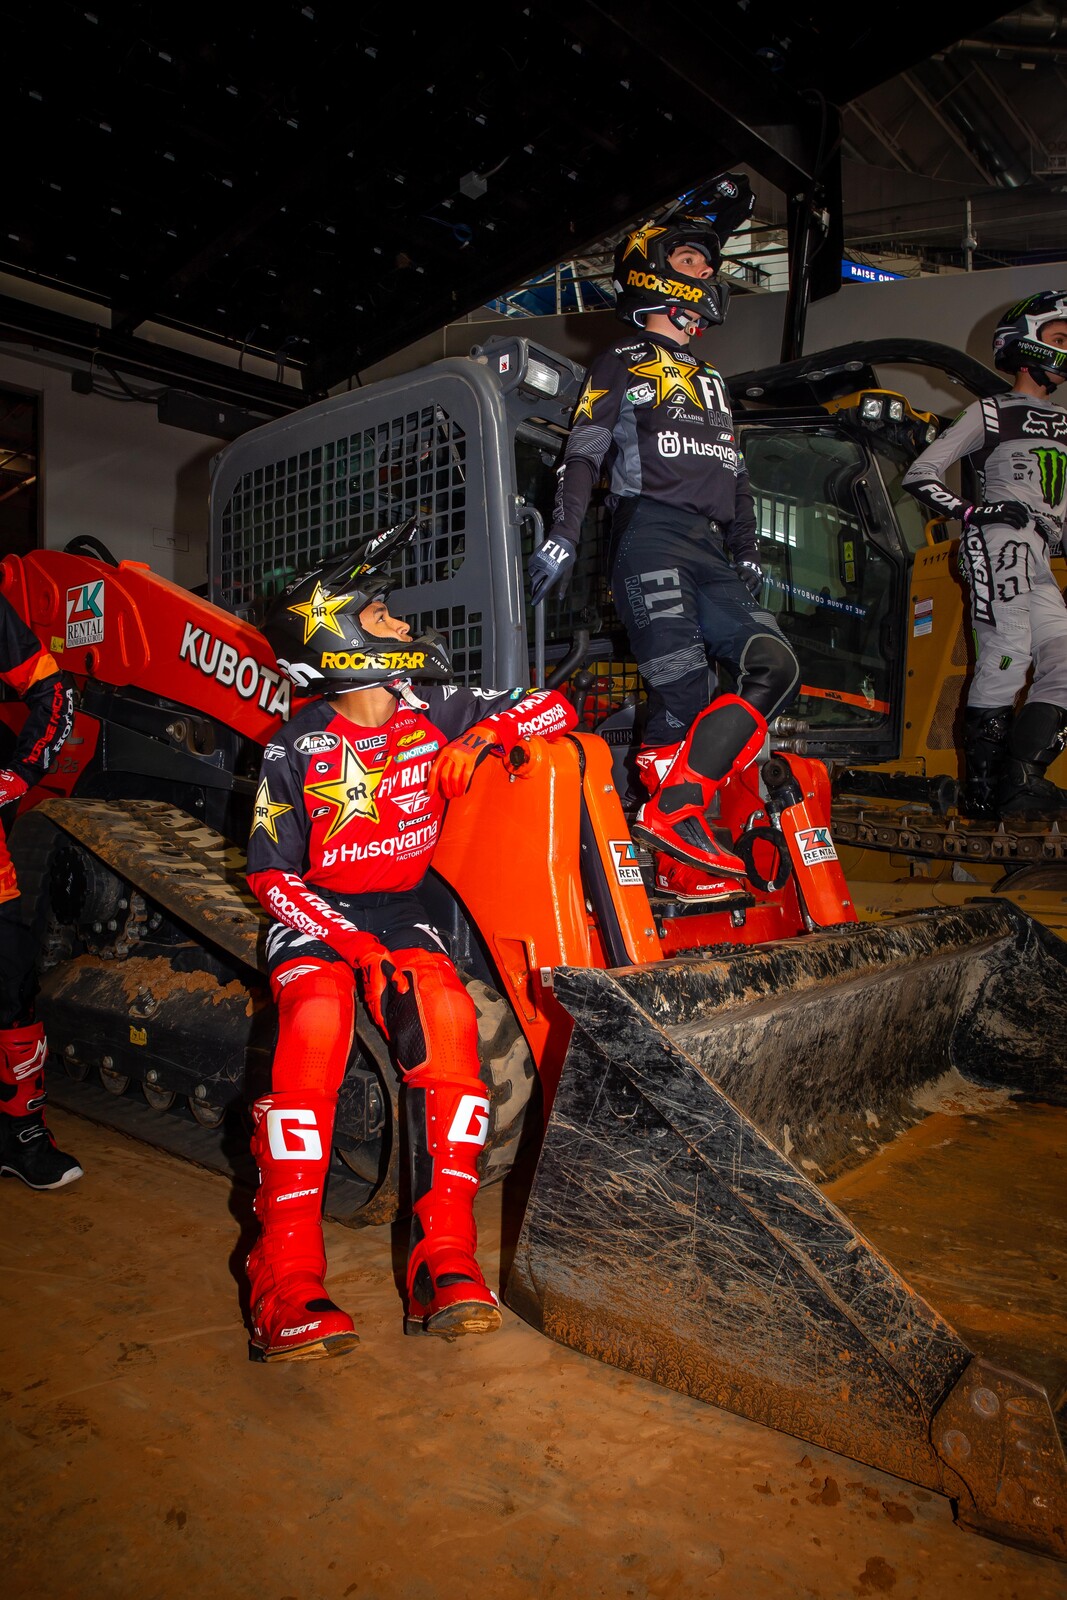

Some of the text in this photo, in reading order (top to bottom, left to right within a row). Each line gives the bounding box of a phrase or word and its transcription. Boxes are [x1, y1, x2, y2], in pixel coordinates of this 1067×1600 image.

[851, 266, 876, 280] RAISE
[626, 269, 703, 303] ROCKSTAR
[1017, 341, 1054, 358] MONSTER
[696, 375, 734, 418] FL
[667, 405, 704, 422] PARADISE
[918, 484, 962, 511] FOX
[974, 504, 1004, 514] FOX
[542, 540, 570, 564] FLY
[68, 582, 104, 624] ZK
[624, 574, 650, 630] RACING
[640, 567, 686, 621] FLY
[68, 619, 103, 640] RENTAL
[180, 621, 291, 723] KUBOTA
[320, 652, 425, 670] ROCKSTAR
[518, 704, 567, 736] ROCKSTAR
[549, 719, 568, 734] DRINK
[300, 735, 336, 750] Airoh
[354, 734, 388, 752] WPS
[404, 743, 437, 760] MOTOREX
[404, 814, 432, 828] SCOTT
[340, 820, 438, 862] Husqvarna
[799, 829, 832, 852] ZK
[396, 850, 423, 862] FACTORY
[804, 848, 836, 860] RENTAL
[266, 885, 329, 938] ROCKSTAR
[448, 1094, 490, 1146] G
[266, 1109, 322, 1160] G
